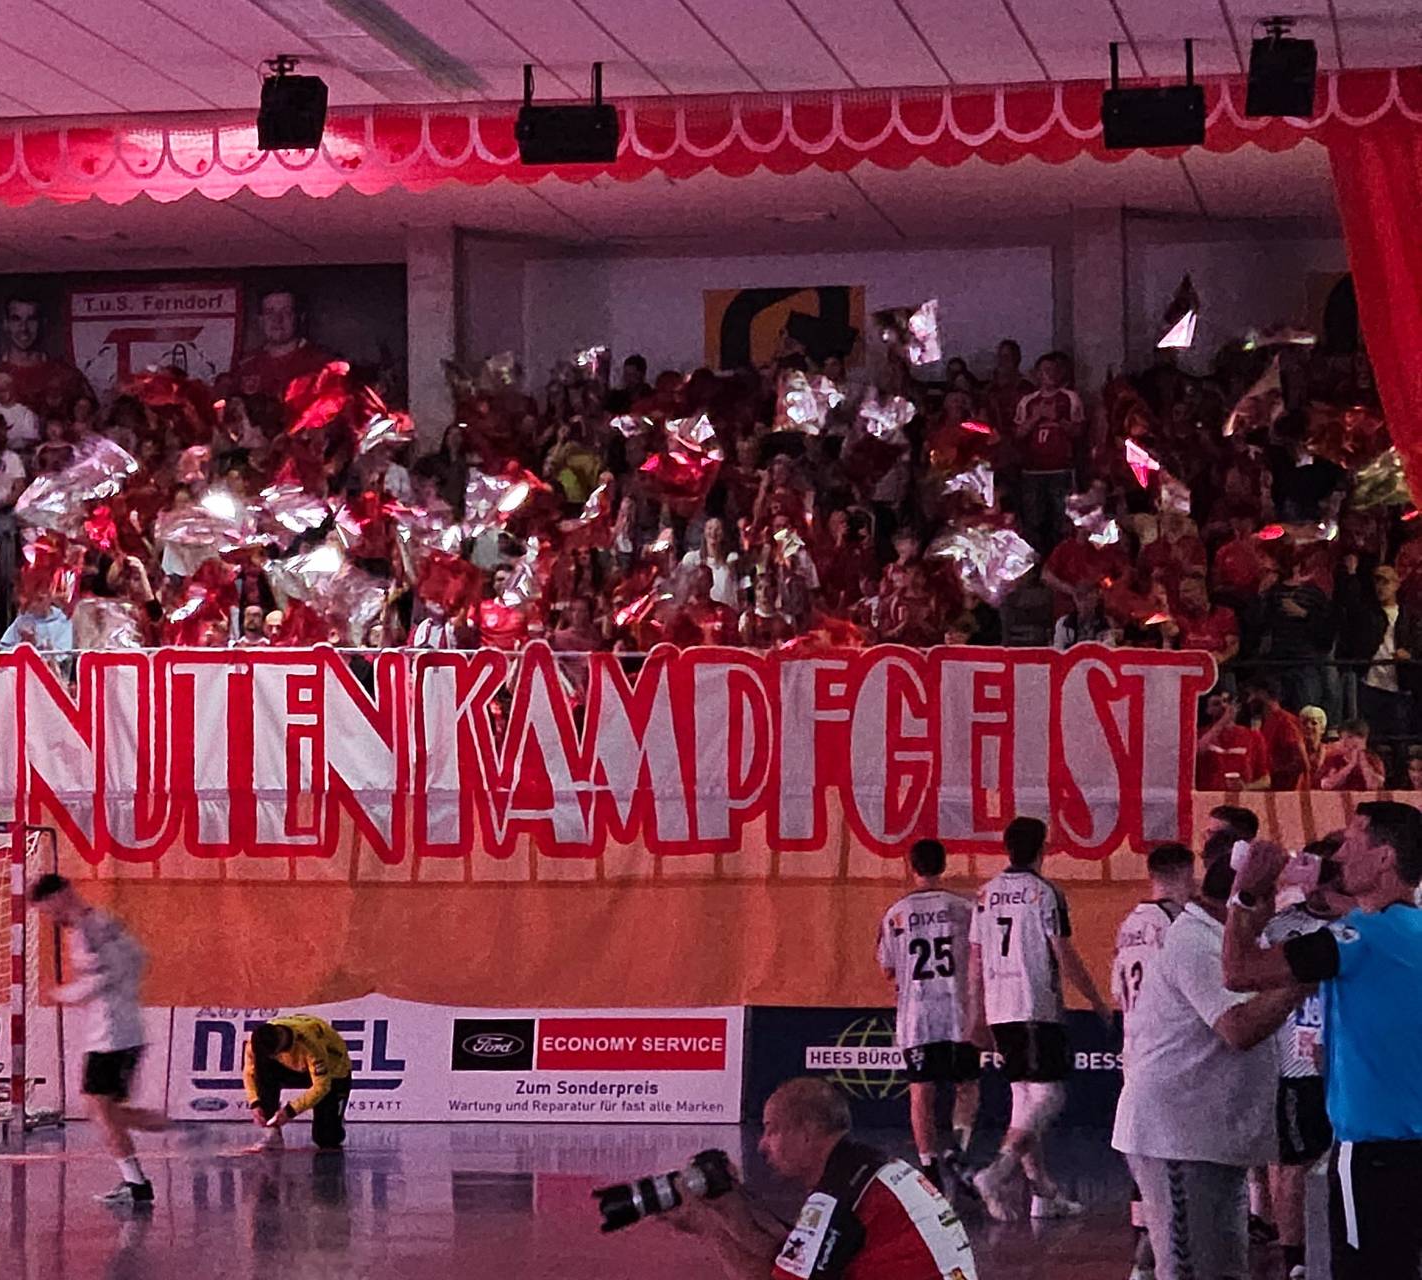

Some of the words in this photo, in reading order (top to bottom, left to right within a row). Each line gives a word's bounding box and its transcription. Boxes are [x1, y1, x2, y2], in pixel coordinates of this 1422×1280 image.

[83, 294, 135, 313] T.u.S.
[142, 293, 224, 311] Ferndorf
[411, 639, 1219, 861] KAMPFGEIST
[989, 887, 1028, 910] pixel
[996, 916, 1014, 957] 7
[908, 936, 956, 981] 25
[472, 1036, 513, 1054] Ford
[542, 1036, 637, 1052] ECONOMY
[642, 1036, 723, 1052] SERVICE
[810, 1051, 853, 1065] HEES
[857, 1047, 903, 1065] BÜRO
[516, 1080, 551, 1095] Zum
[557, 1080, 658, 1099] Sonderpreis
[449, 1100, 502, 1113] Wartung
[506, 1100, 529, 1112] und
[533, 1100, 595, 1114] Reparatur
[600, 1100, 618, 1113] für
[621, 1100, 645, 1113] fast
[649, 1101, 672, 1113] alle
[676, 1101, 725, 1114] Marken
